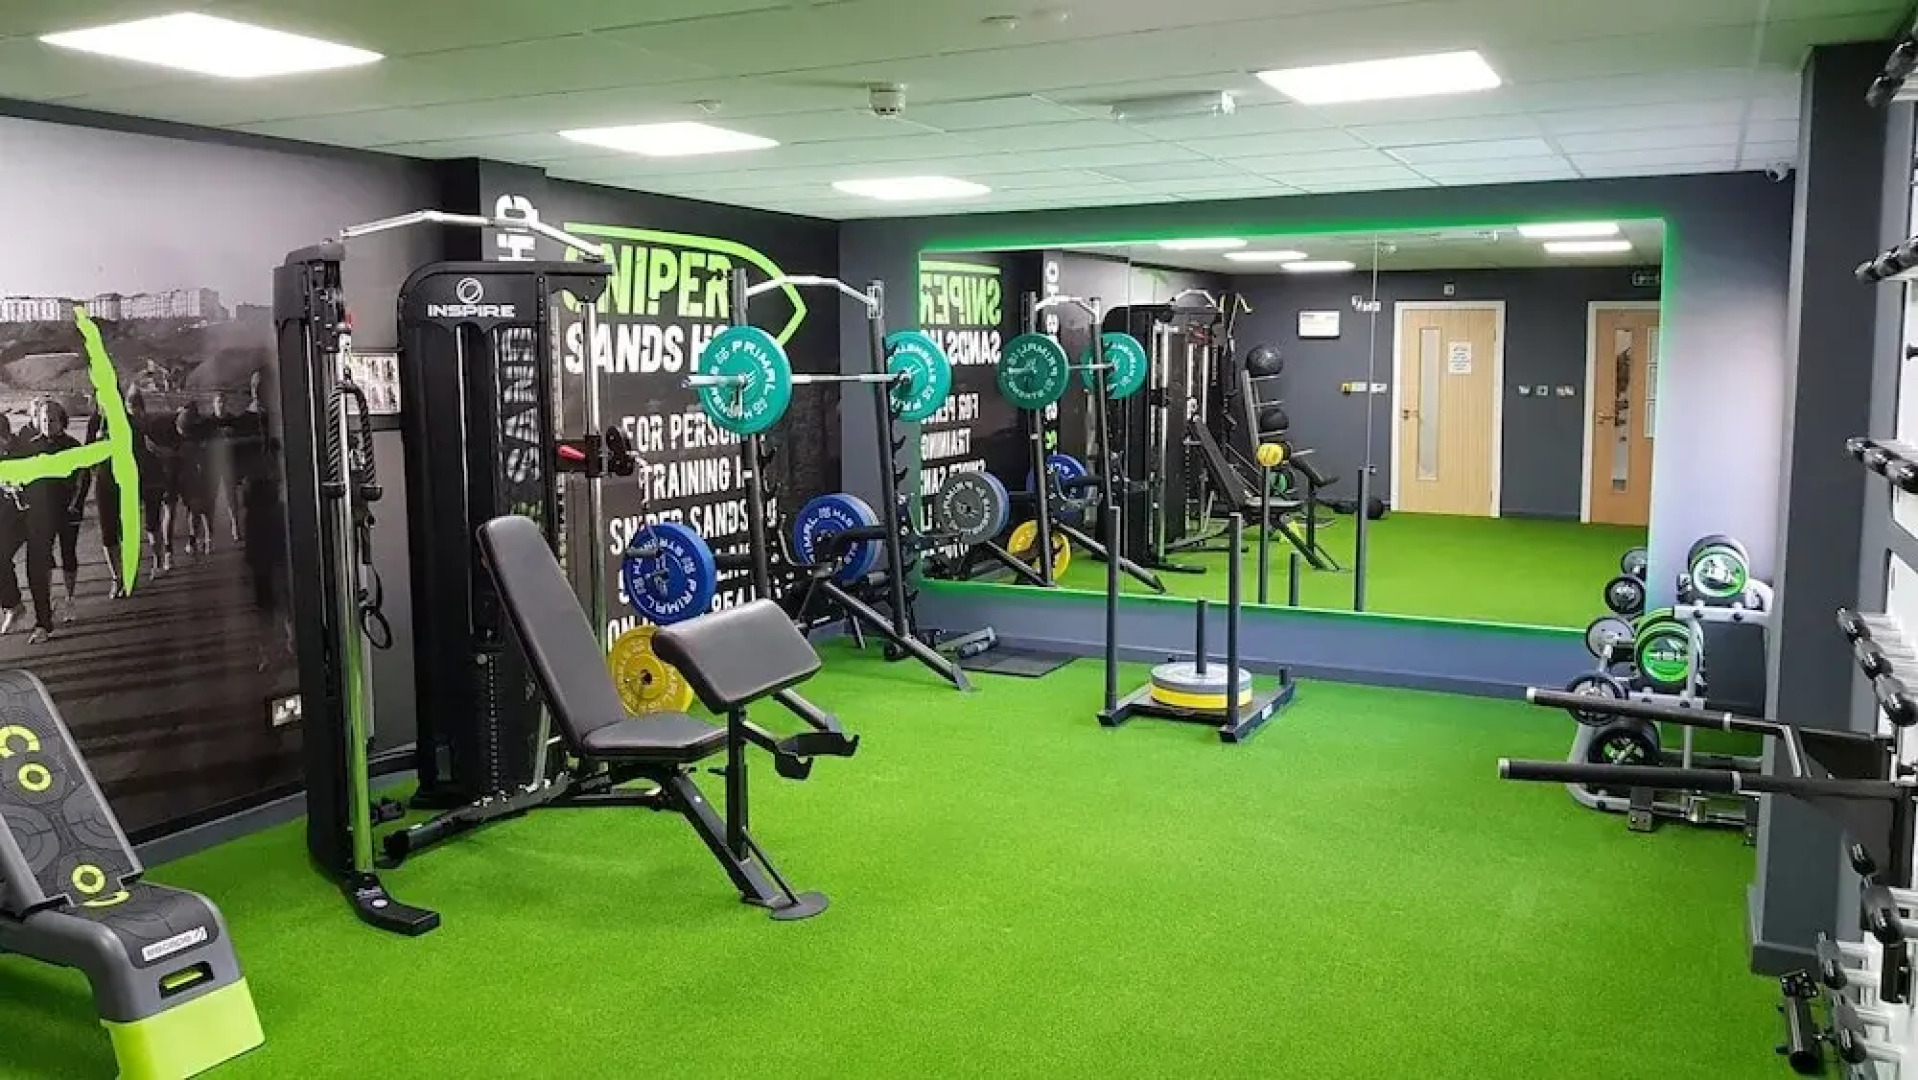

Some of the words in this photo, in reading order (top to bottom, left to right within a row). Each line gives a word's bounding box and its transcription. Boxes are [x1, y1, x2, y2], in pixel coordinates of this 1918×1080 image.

[427, 304, 516, 318] INSPIRE
[732, 340, 775, 395] PRIMAL
[639, 456, 731, 503] TRAINING
